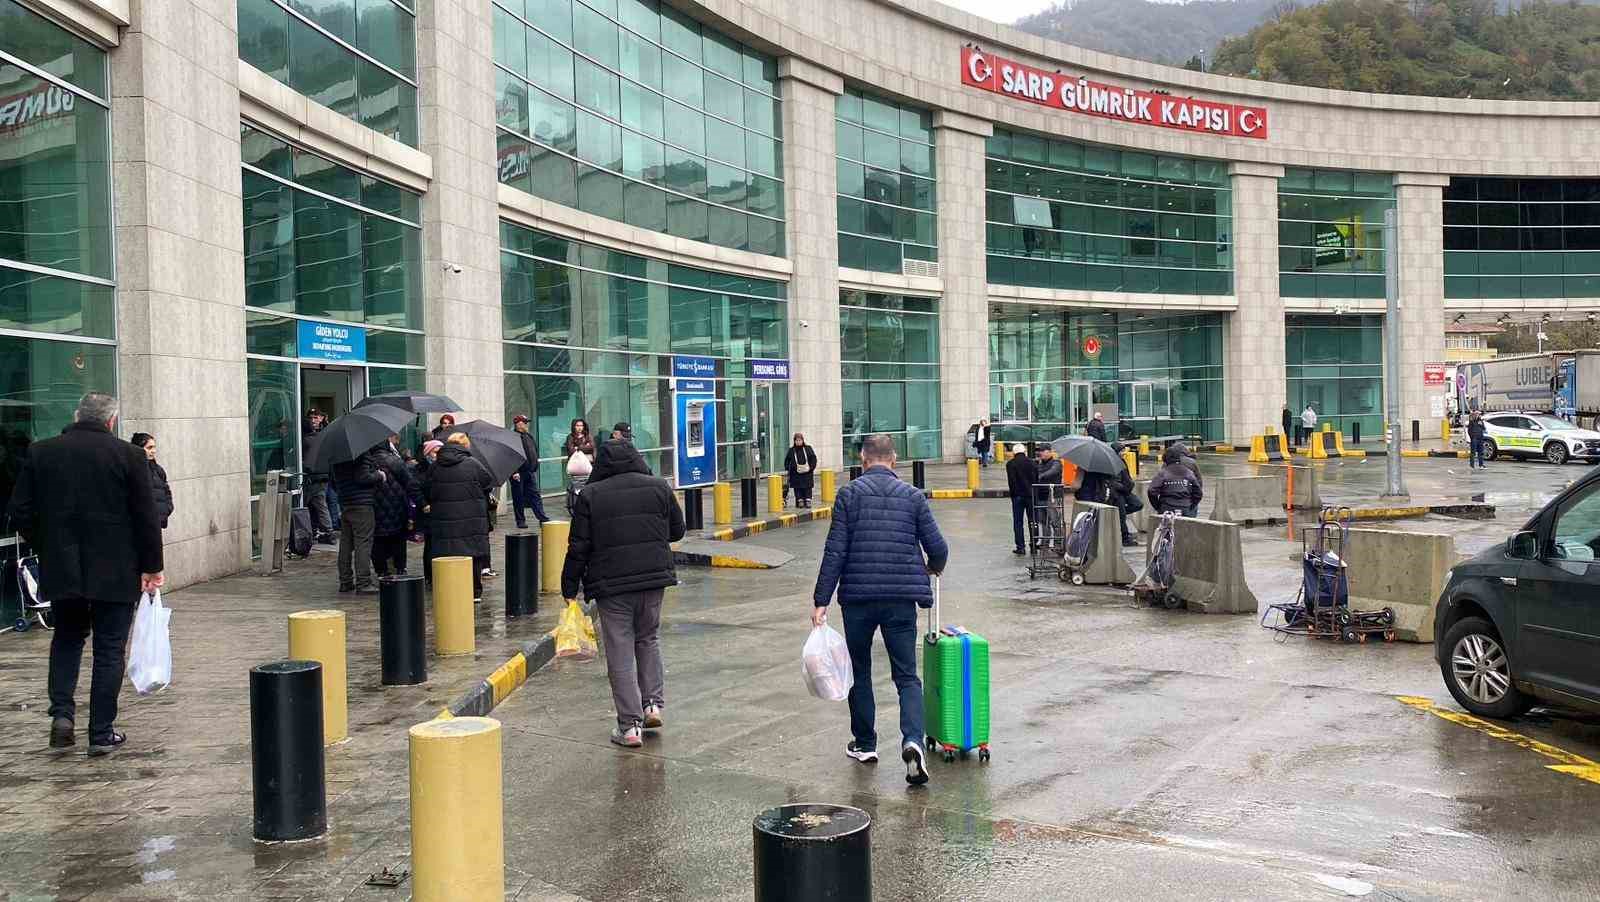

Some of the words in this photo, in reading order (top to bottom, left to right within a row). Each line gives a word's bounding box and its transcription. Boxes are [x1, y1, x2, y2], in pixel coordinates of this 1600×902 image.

[1001, 65, 1055, 101] SARP
[1060, 80, 1153, 121] GÜMRÜK
[1161, 100, 1230, 131] KAPISI
[754, 364, 775, 375] PERSONEL
